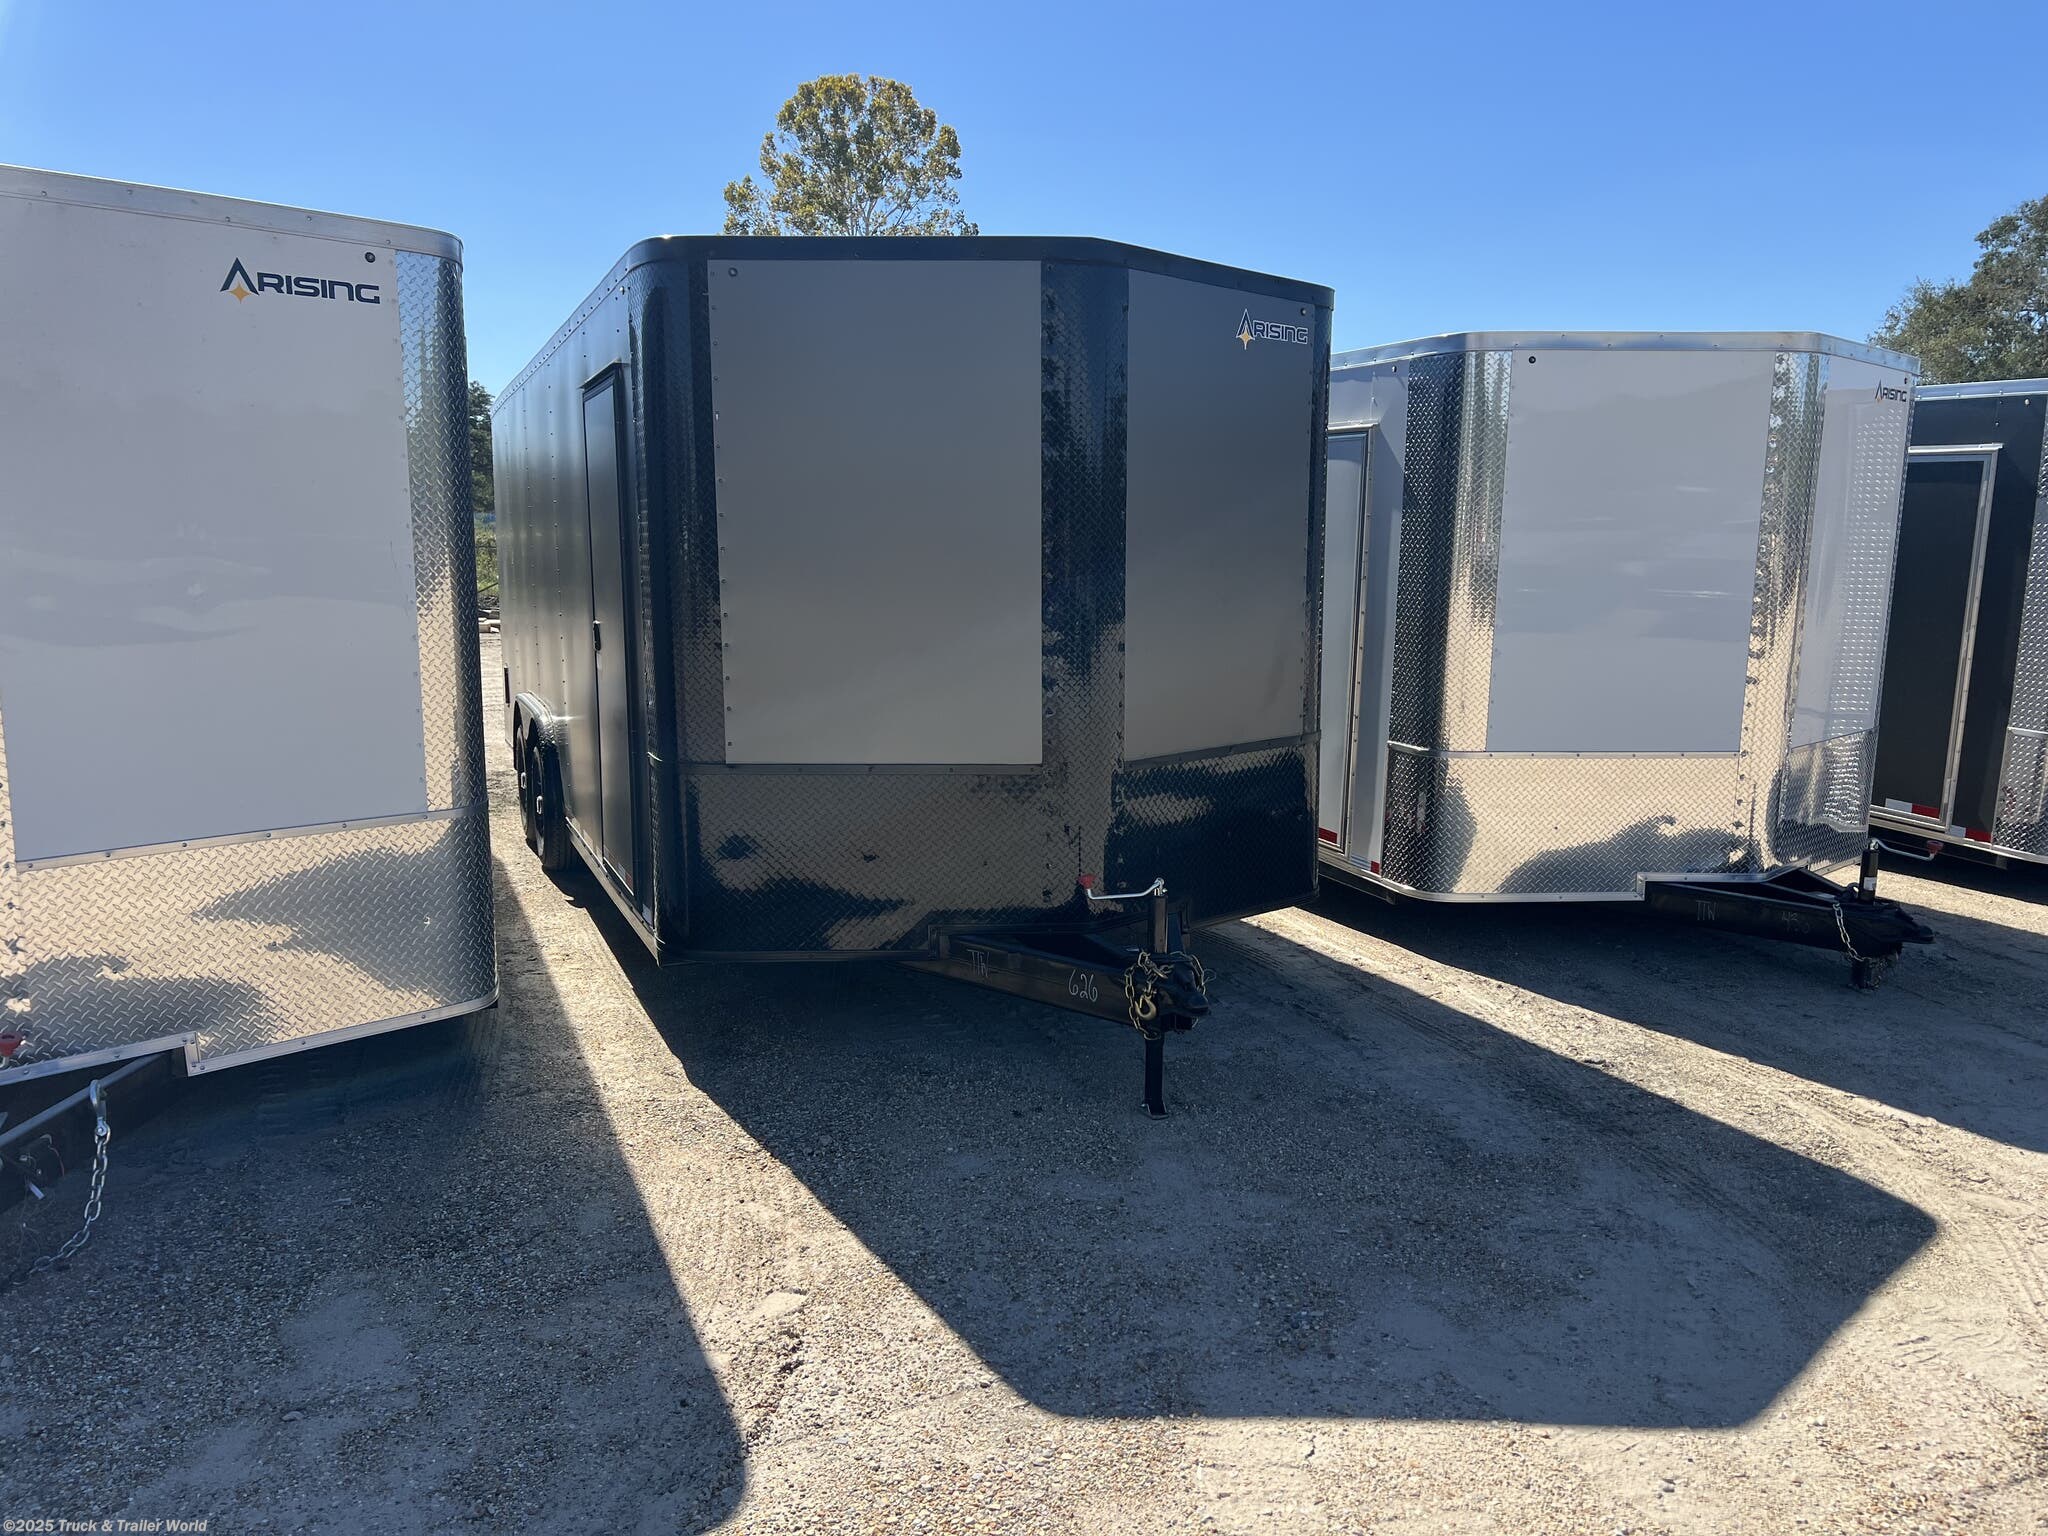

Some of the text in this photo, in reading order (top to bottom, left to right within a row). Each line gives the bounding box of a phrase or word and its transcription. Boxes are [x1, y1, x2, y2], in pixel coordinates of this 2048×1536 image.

[219, 257, 381, 304] ARISING
[1236, 308, 1308, 345] ARISING
[1068, 969, 1098, 1002] 626
